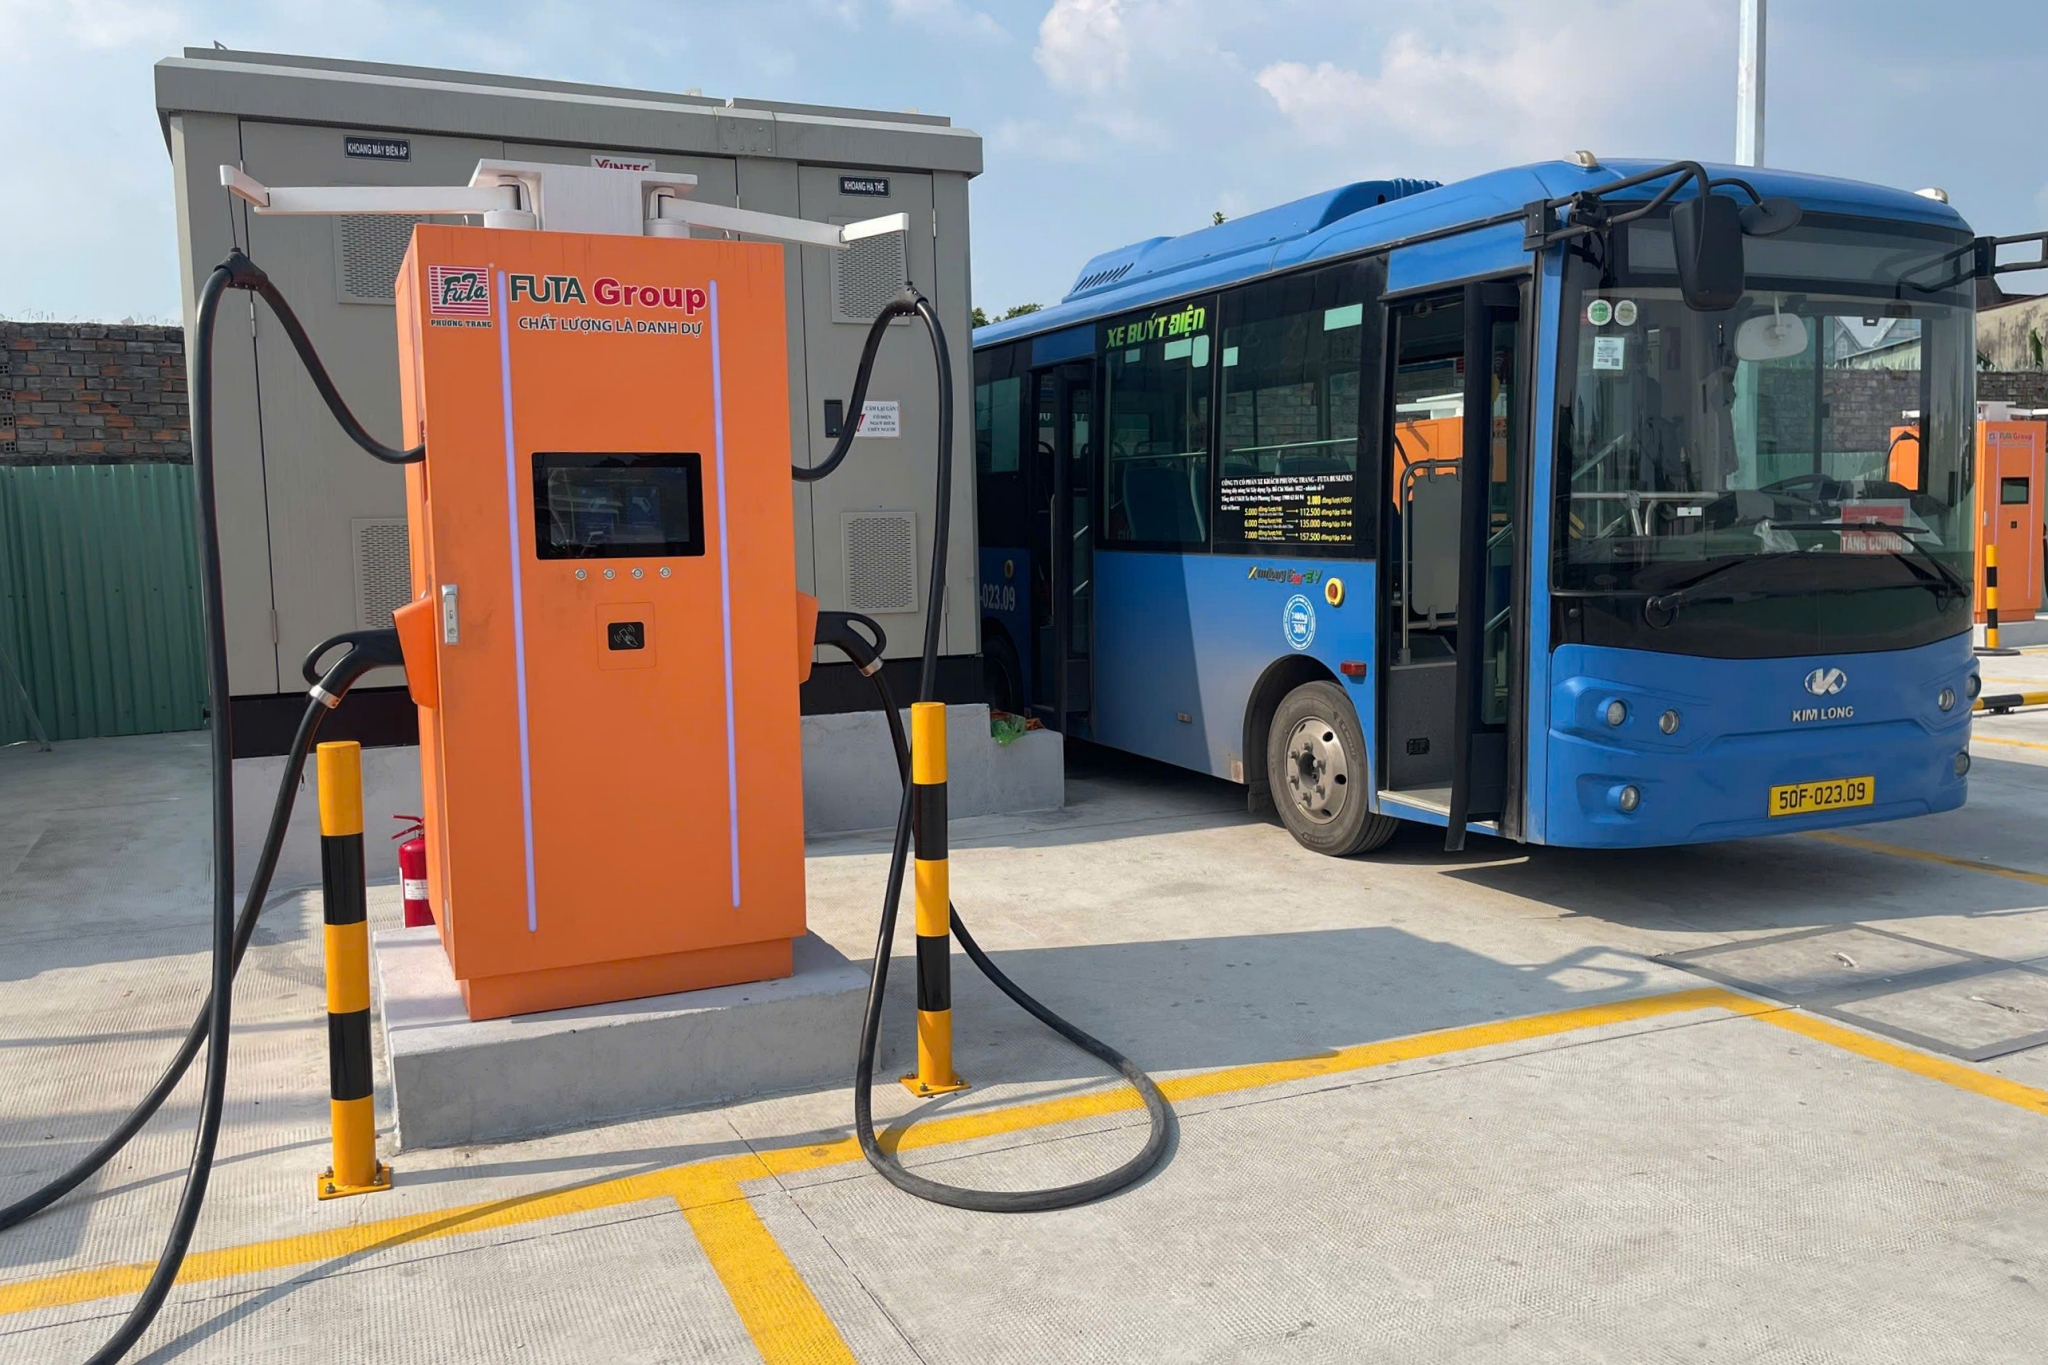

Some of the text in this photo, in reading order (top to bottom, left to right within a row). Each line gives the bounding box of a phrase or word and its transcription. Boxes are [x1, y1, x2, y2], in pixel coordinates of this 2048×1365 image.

[348, 142, 372, 154] KHOANG
[372, 142, 384, 155] MÁY
[400, 144, 408, 156] ÁP
[844, 180, 885, 193] KHOANG HẠ THẾ
[509, 274, 707, 315] FUTA Group
[465, 320, 492, 328] TRANG
[518, 314, 702, 338] CHẤT LƯỢNG LÀ DANH DỰ
[1106, 304, 1206, 348] XE BUÝT ĐIỆN
[1244, 508, 1257, 516] 5.000
[1300, 508, 1320, 516] 112.500
[1300, 520, 1320, 528] 135.000
[1300, 532, 1320, 540] 157.500
[1293, 624, 1306, 634] 30N
[1792, 706, 1854, 722] KIM LONG
[1779, 782, 1866, 810] 50F-023.09
